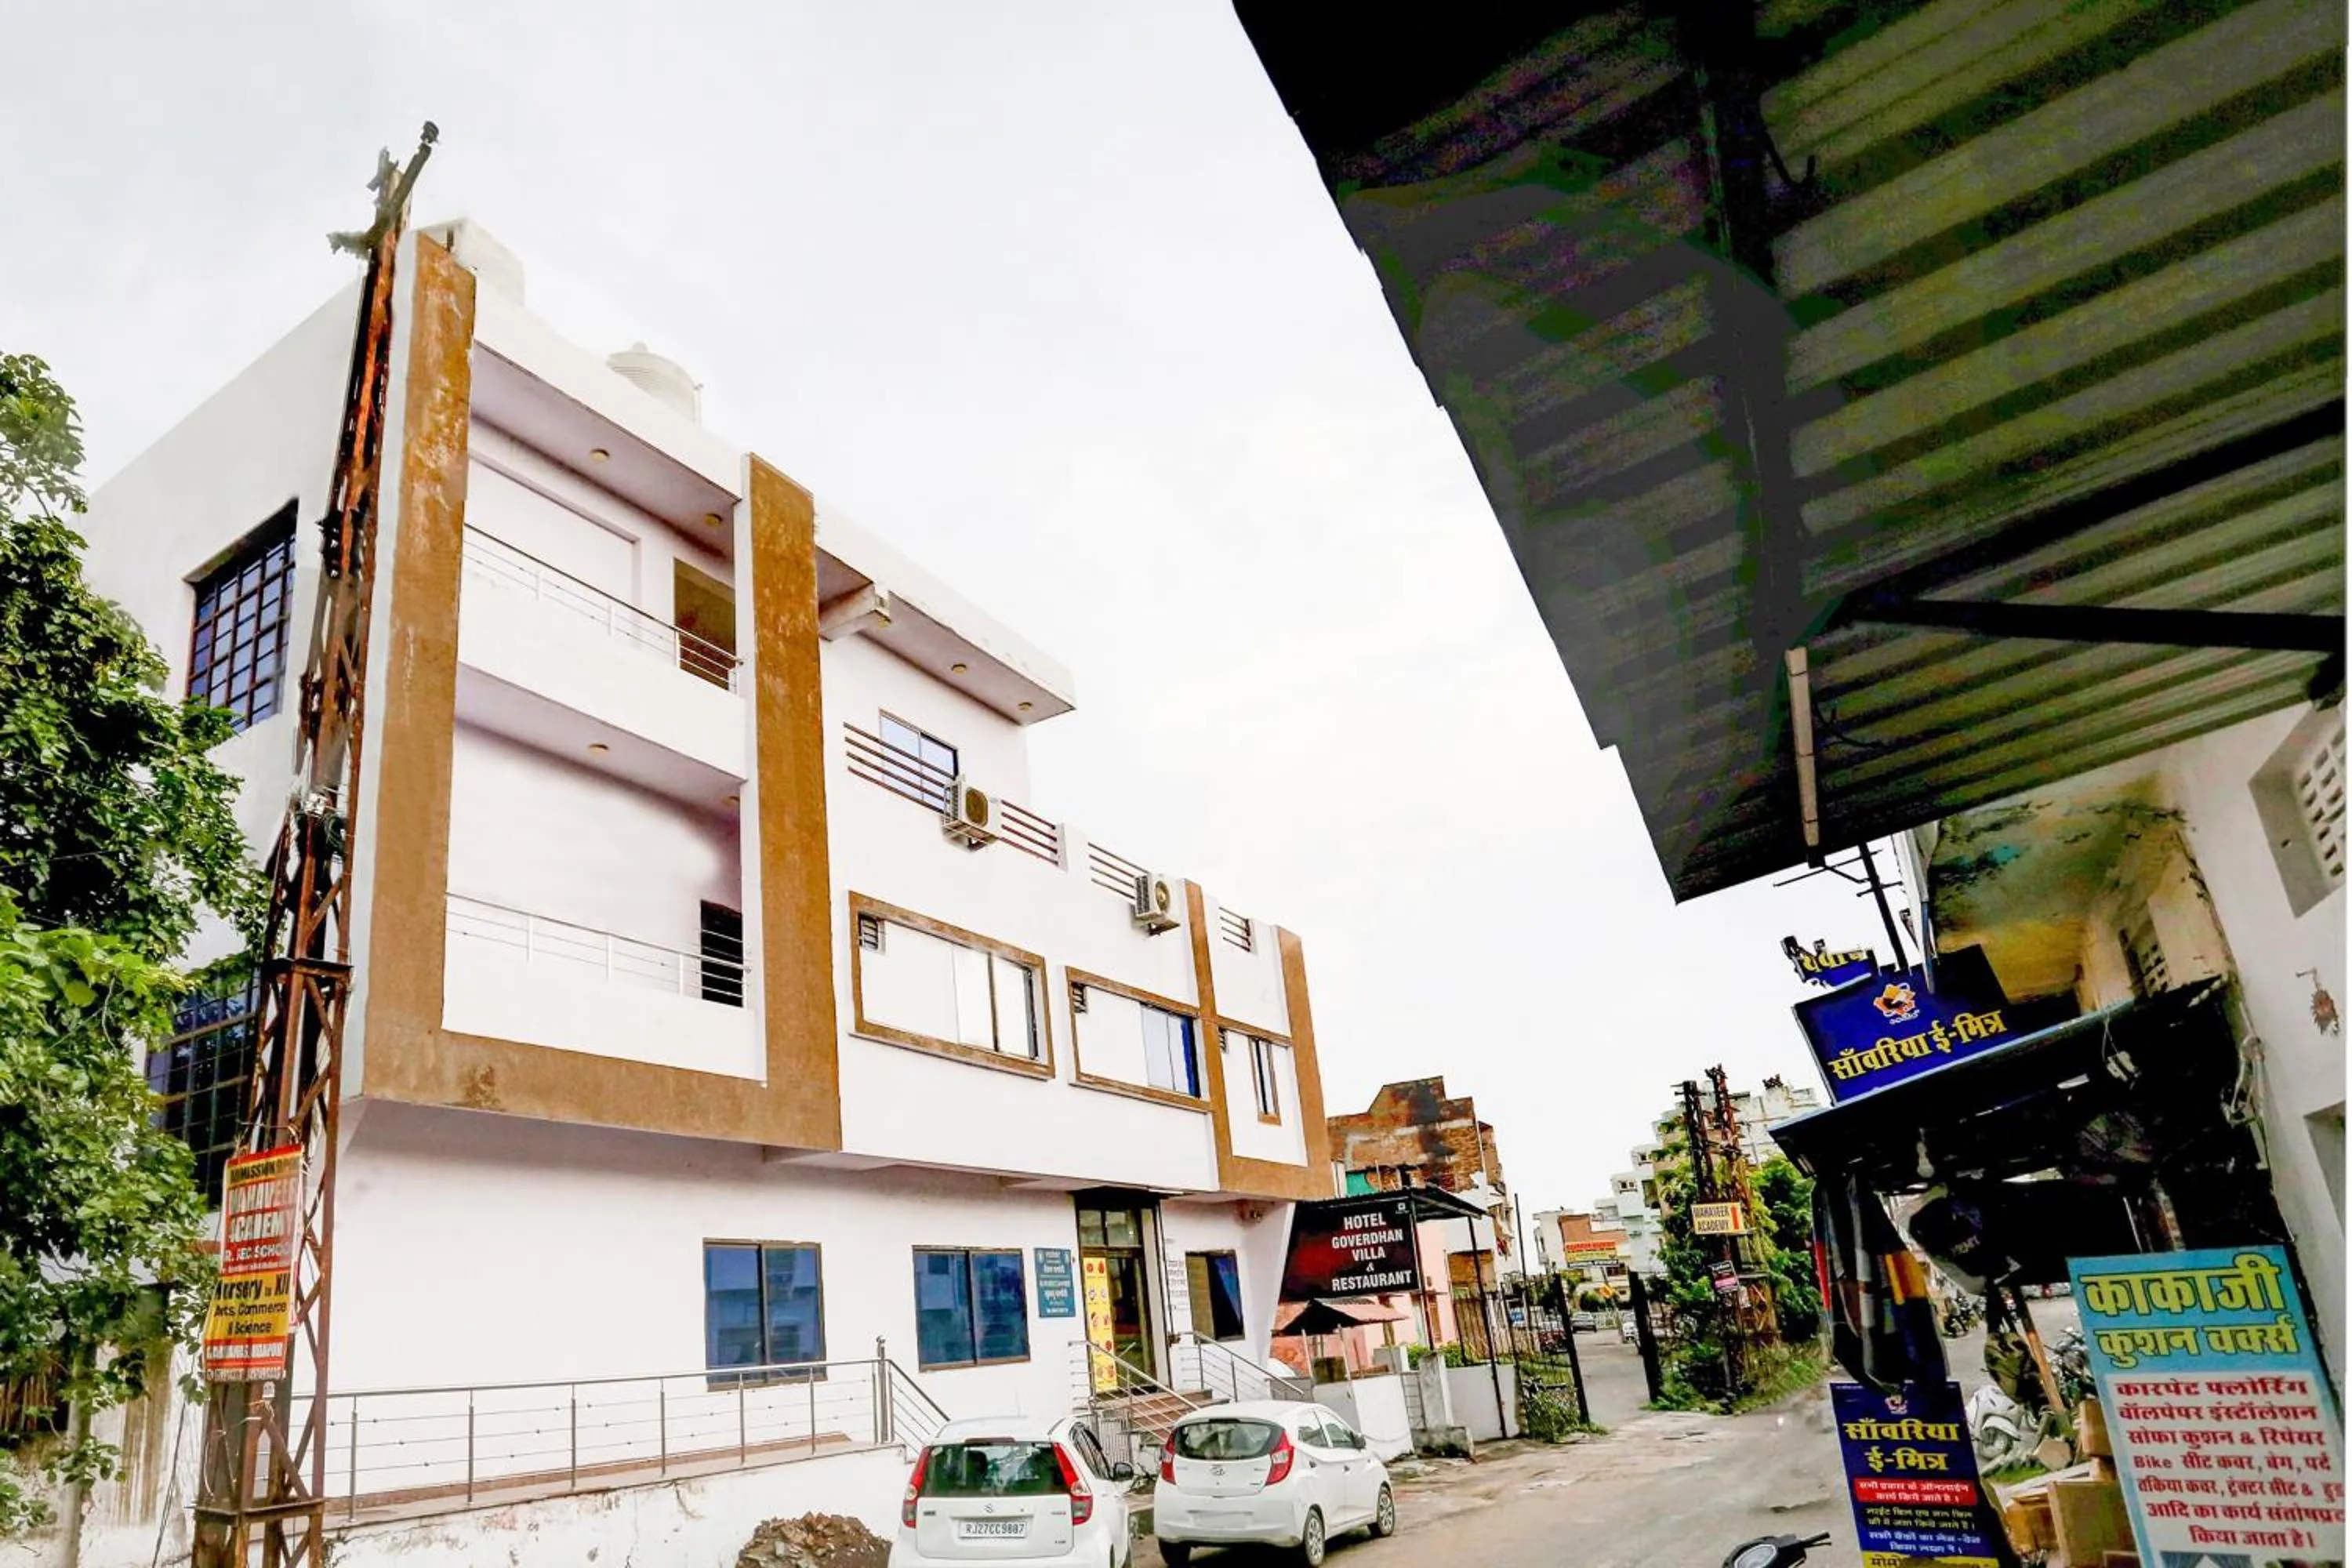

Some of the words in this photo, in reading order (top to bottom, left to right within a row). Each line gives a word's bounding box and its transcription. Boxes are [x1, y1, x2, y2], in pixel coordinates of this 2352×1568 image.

[1344, 1211, 1386, 1230] HOTEL
[1331, 1229, 1403, 1249] GOVERDHAN
[1352, 1247, 1386, 1261] VILLA
[1366, 1262, 1374, 1272] &
[1331, 1270, 1412, 1291] RESTAURANT
[2078, 1252, 2286, 1316] काकाजी
[2093, 1327, 2200, 1369] कुशन
[2115, 1377, 2200, 1396] कारपेट
[2126, 1425, 2177, 1445] सोफा
[2181, 1428, 2234, 1449] कुशन
[2239, 1432, 2255, 1444] &
[2133, 1455, 2172, 1468] Bike
[2180, 1450, 2212, 1468] सीट
[2269, 1476, 2298, 1497] सीट
[2301, 1482, 2314, 1497] &
[2146, 1501, 2190, 1519] आदि
[2192, 1504, 2219, 1519] का
[2221, 1501, 2263, 1520] कार्य
[2189, 1524, 2238, 1545] किया
[2242, 1530, 2288, 1547] जाता
